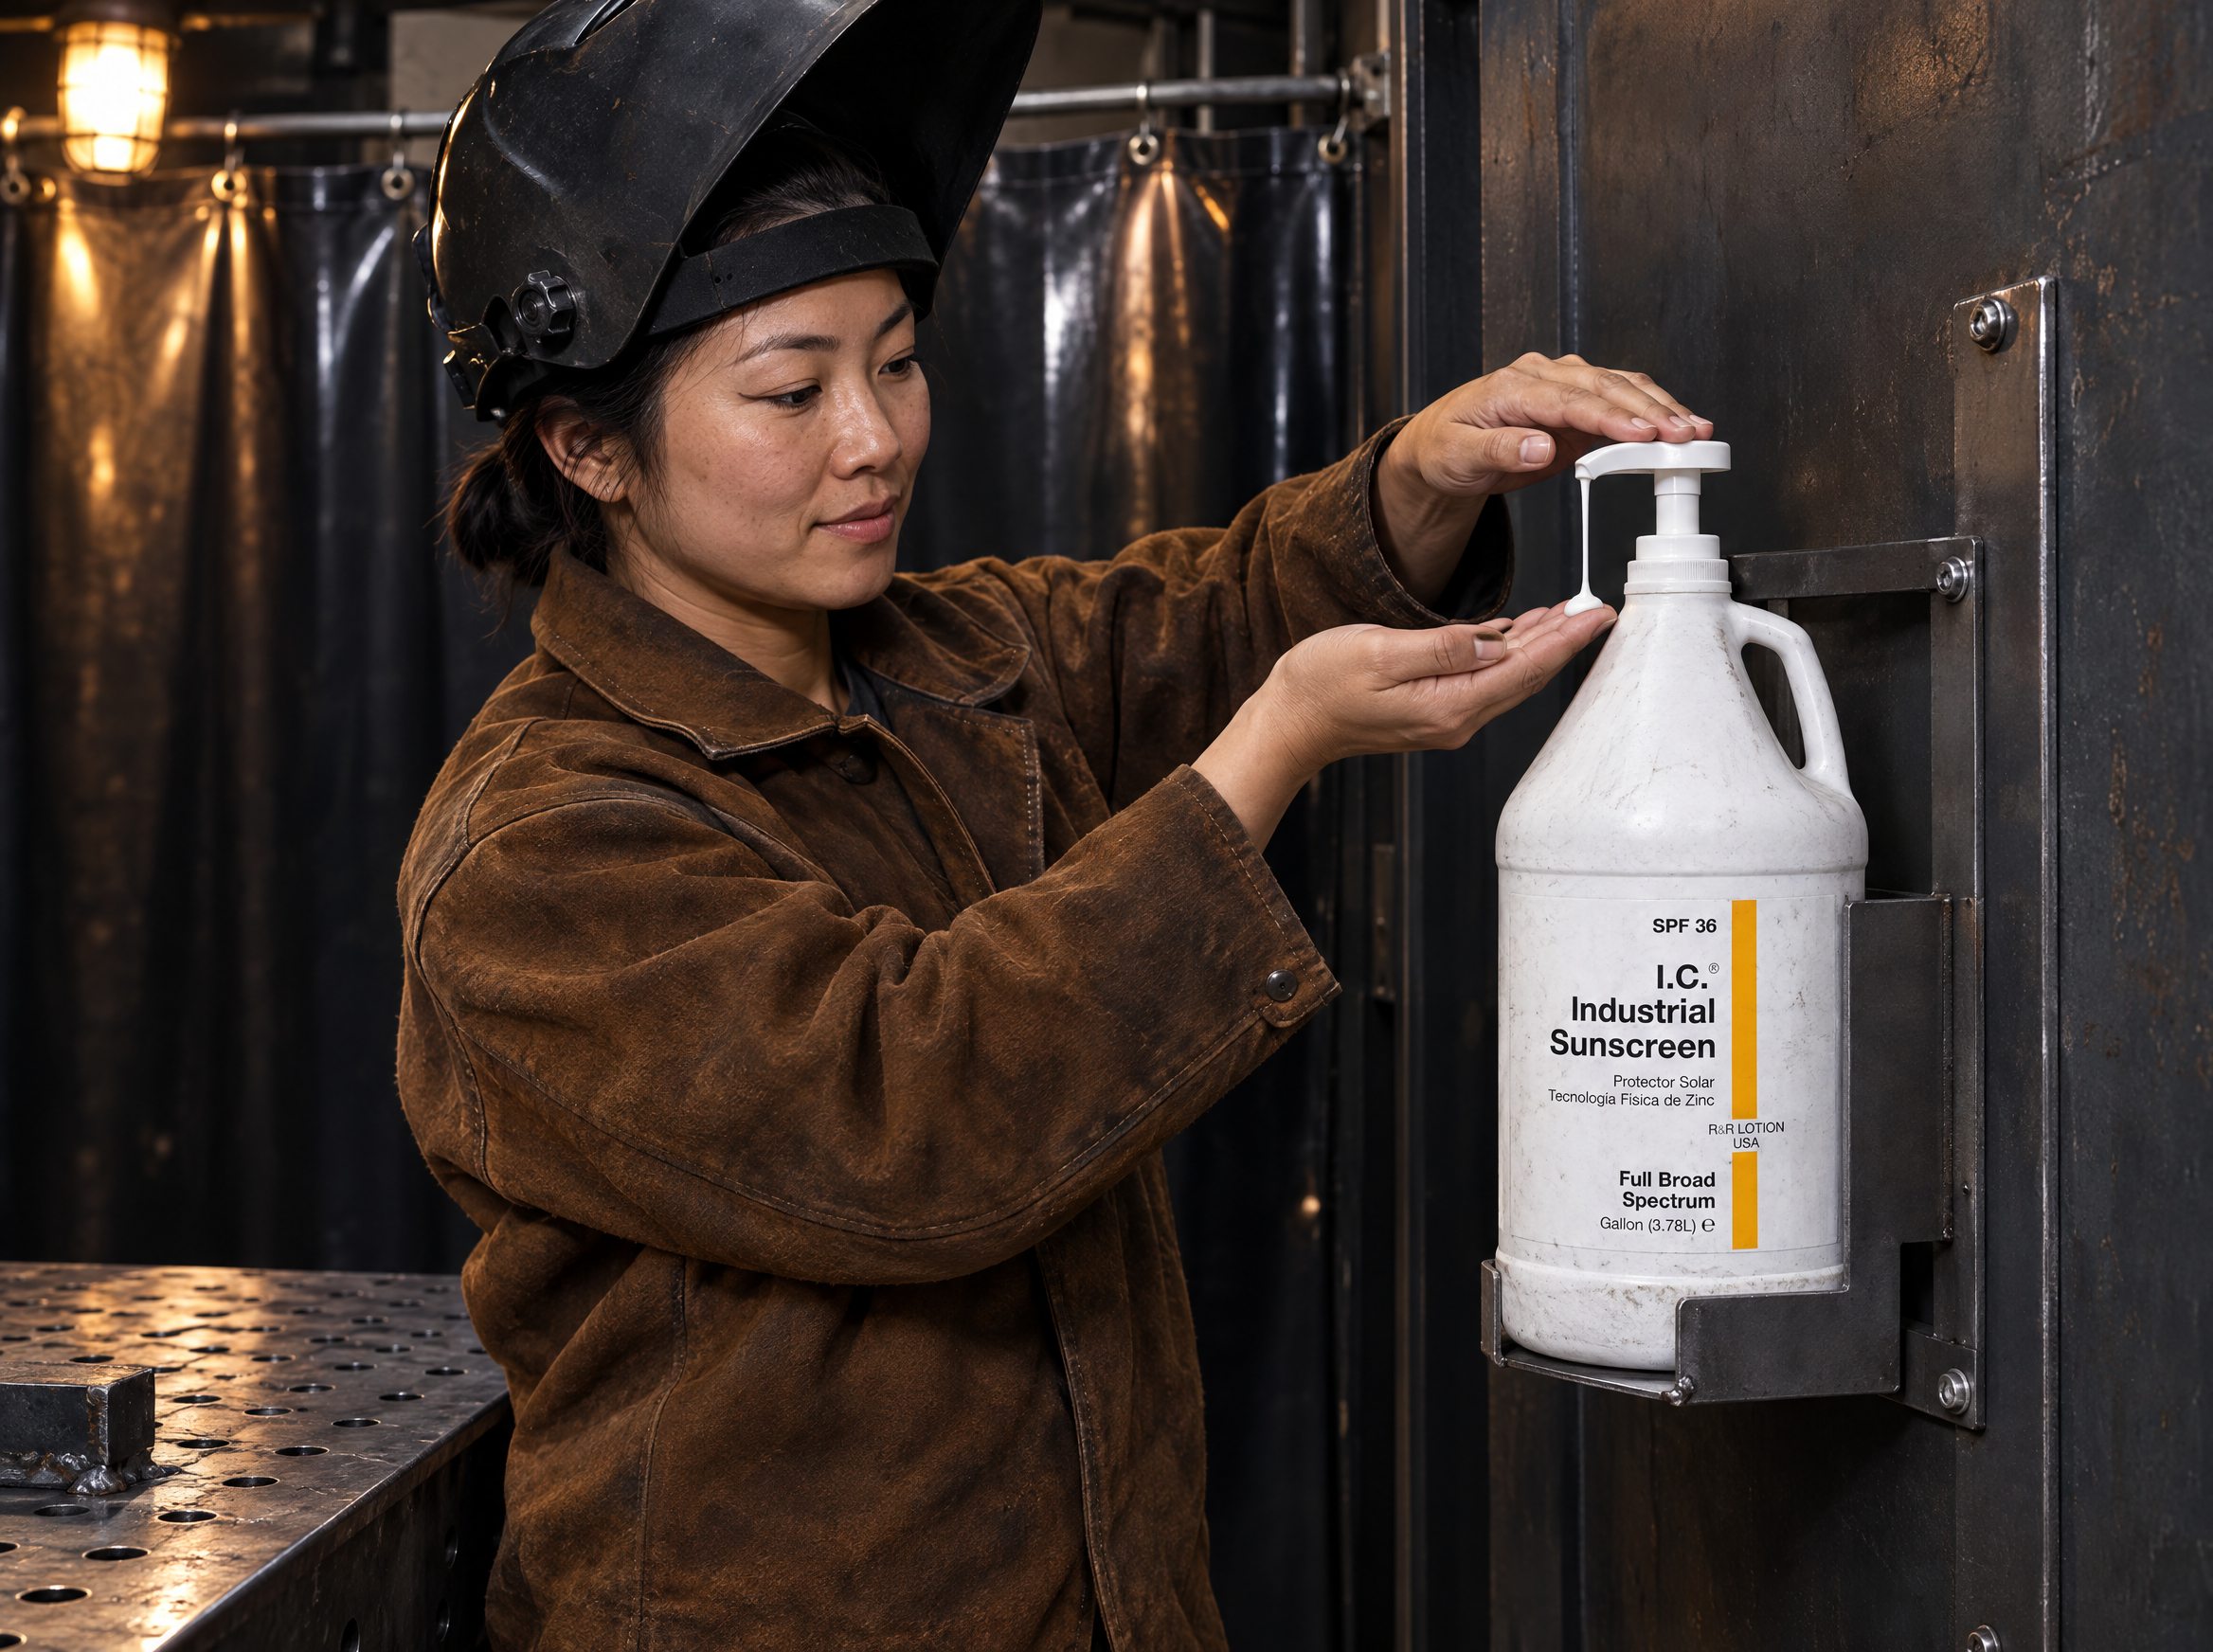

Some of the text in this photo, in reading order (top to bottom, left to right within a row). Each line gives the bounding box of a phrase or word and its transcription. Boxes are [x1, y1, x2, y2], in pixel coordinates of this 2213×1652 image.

[1653, 919, 1717, 933] SPF 36
[1573, 997, 1716, 1024] Industrial
[1550, 1029, 1716, 1059] Sunscreen
[1613, 1074, 1716, 1088] Protector Solar
[1664, 1094, 1682, 1106] de
[1685, 1094, 1716, 1106] Zinc
[1708, 1121, 1785, 1135] R&R LOTION
[1733, 1137, 1760, 1149] USA
[1620, 1171, 1716, 1188] Full Broad
[1623, 1192, 1716, 1211] Spectrum
[1600, 1216, 1644, 1231] Gallon
[1648, 1219, 1697, 1235] (3.78L)
